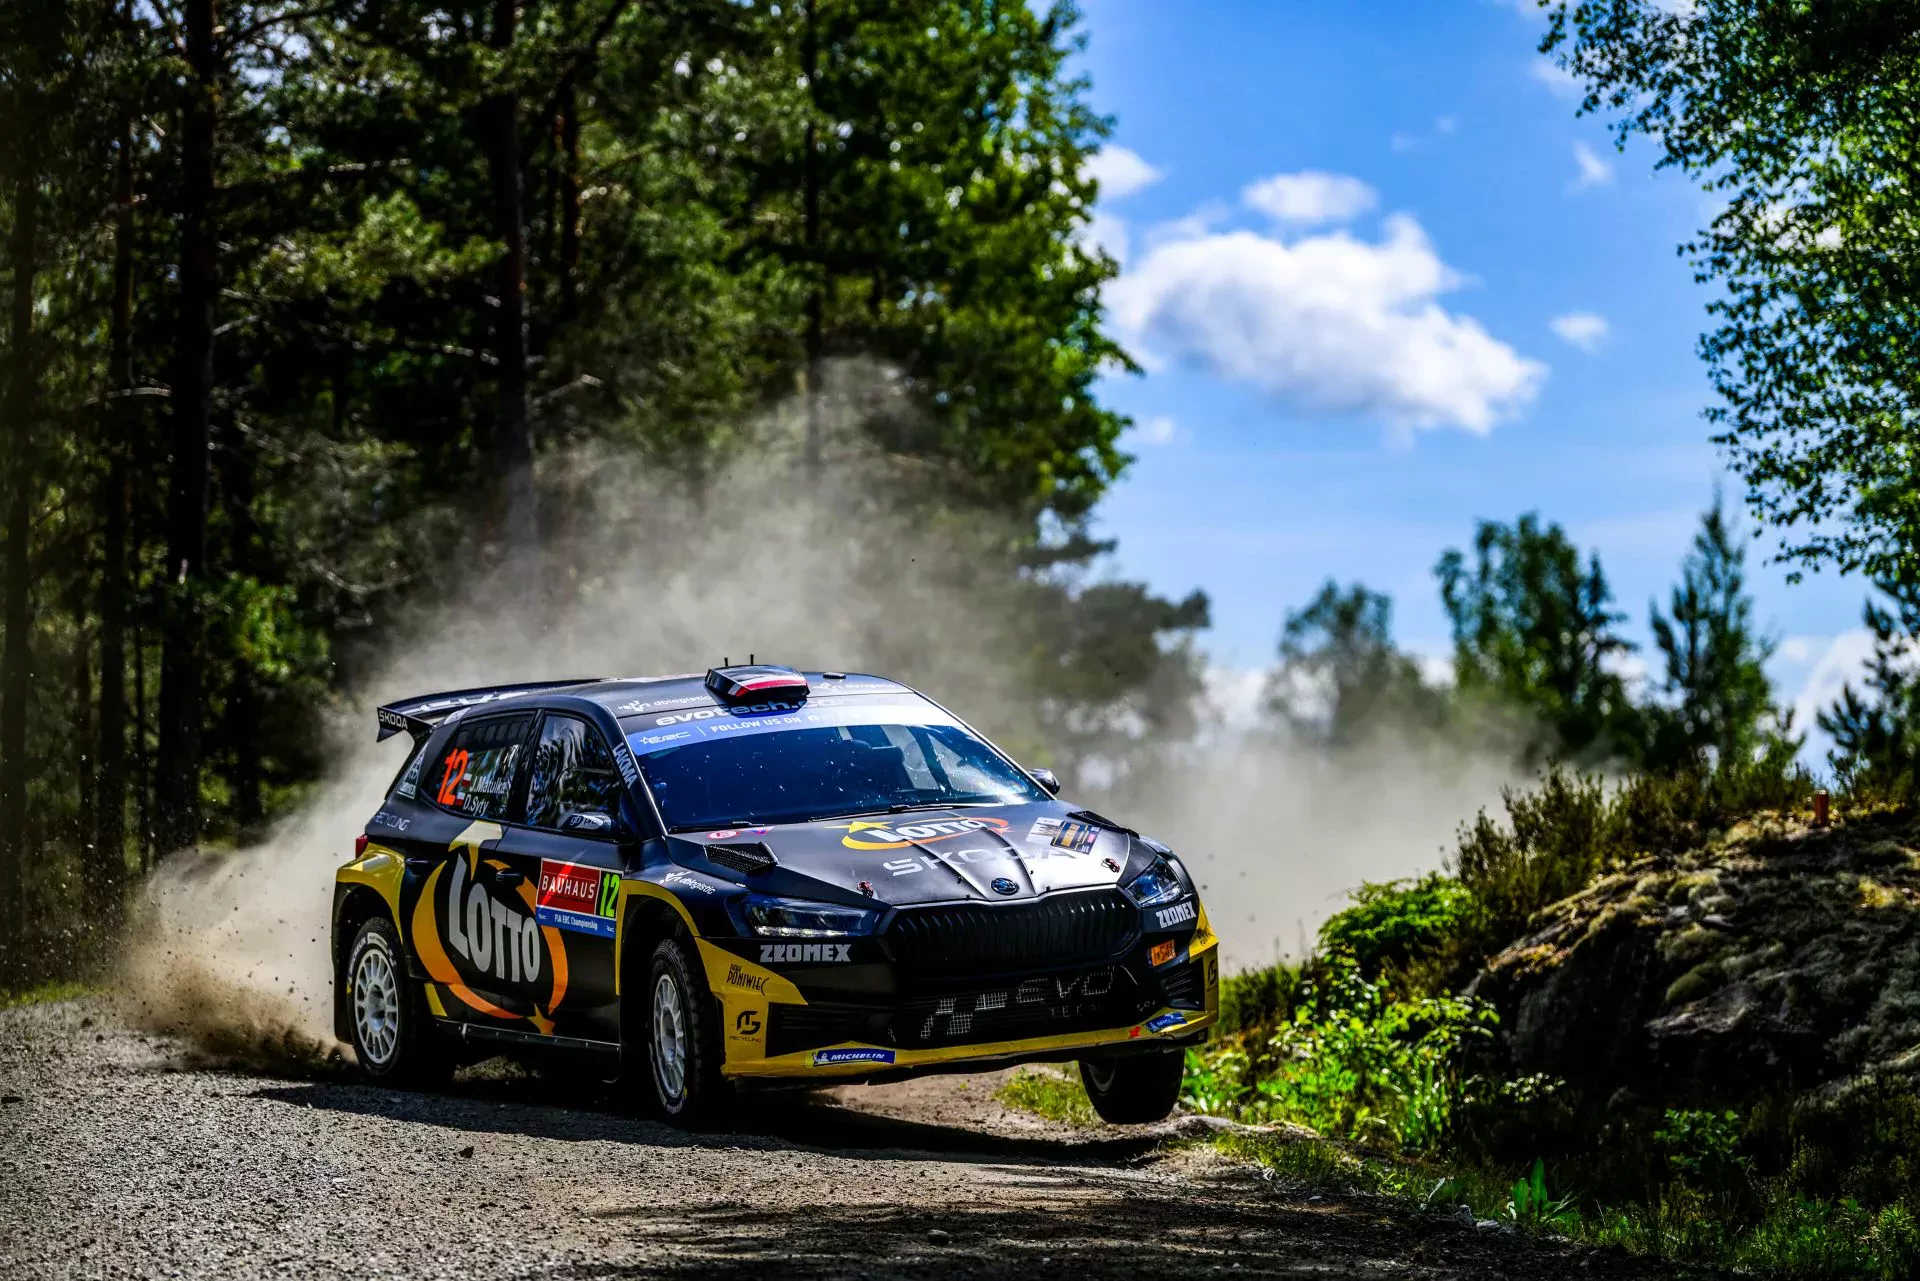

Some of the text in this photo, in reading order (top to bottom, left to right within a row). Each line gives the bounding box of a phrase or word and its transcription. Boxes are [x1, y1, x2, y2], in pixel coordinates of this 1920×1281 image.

[378, 710, 408, 730] SKODA
[656, 699, 850, 726] evotech.co
[710, 719, 761, 733] FOLLOW
[762, 718, 781, 726] US
[783, 716, 801, 724] ON
[437, 748, 469, 806] 12
[612, 742, 638, 790] LAKMA
[463, 794, 489, 817] D.Syty
[864, 819, 988, 842] LOTTO
[541, 873, 620, 918] BAUHAUS 12
[449, 853, 541, 983] LOTTO
[570, 917, 598, 932] Championship
[831, 1052, 885, 1061] MICHELIN
